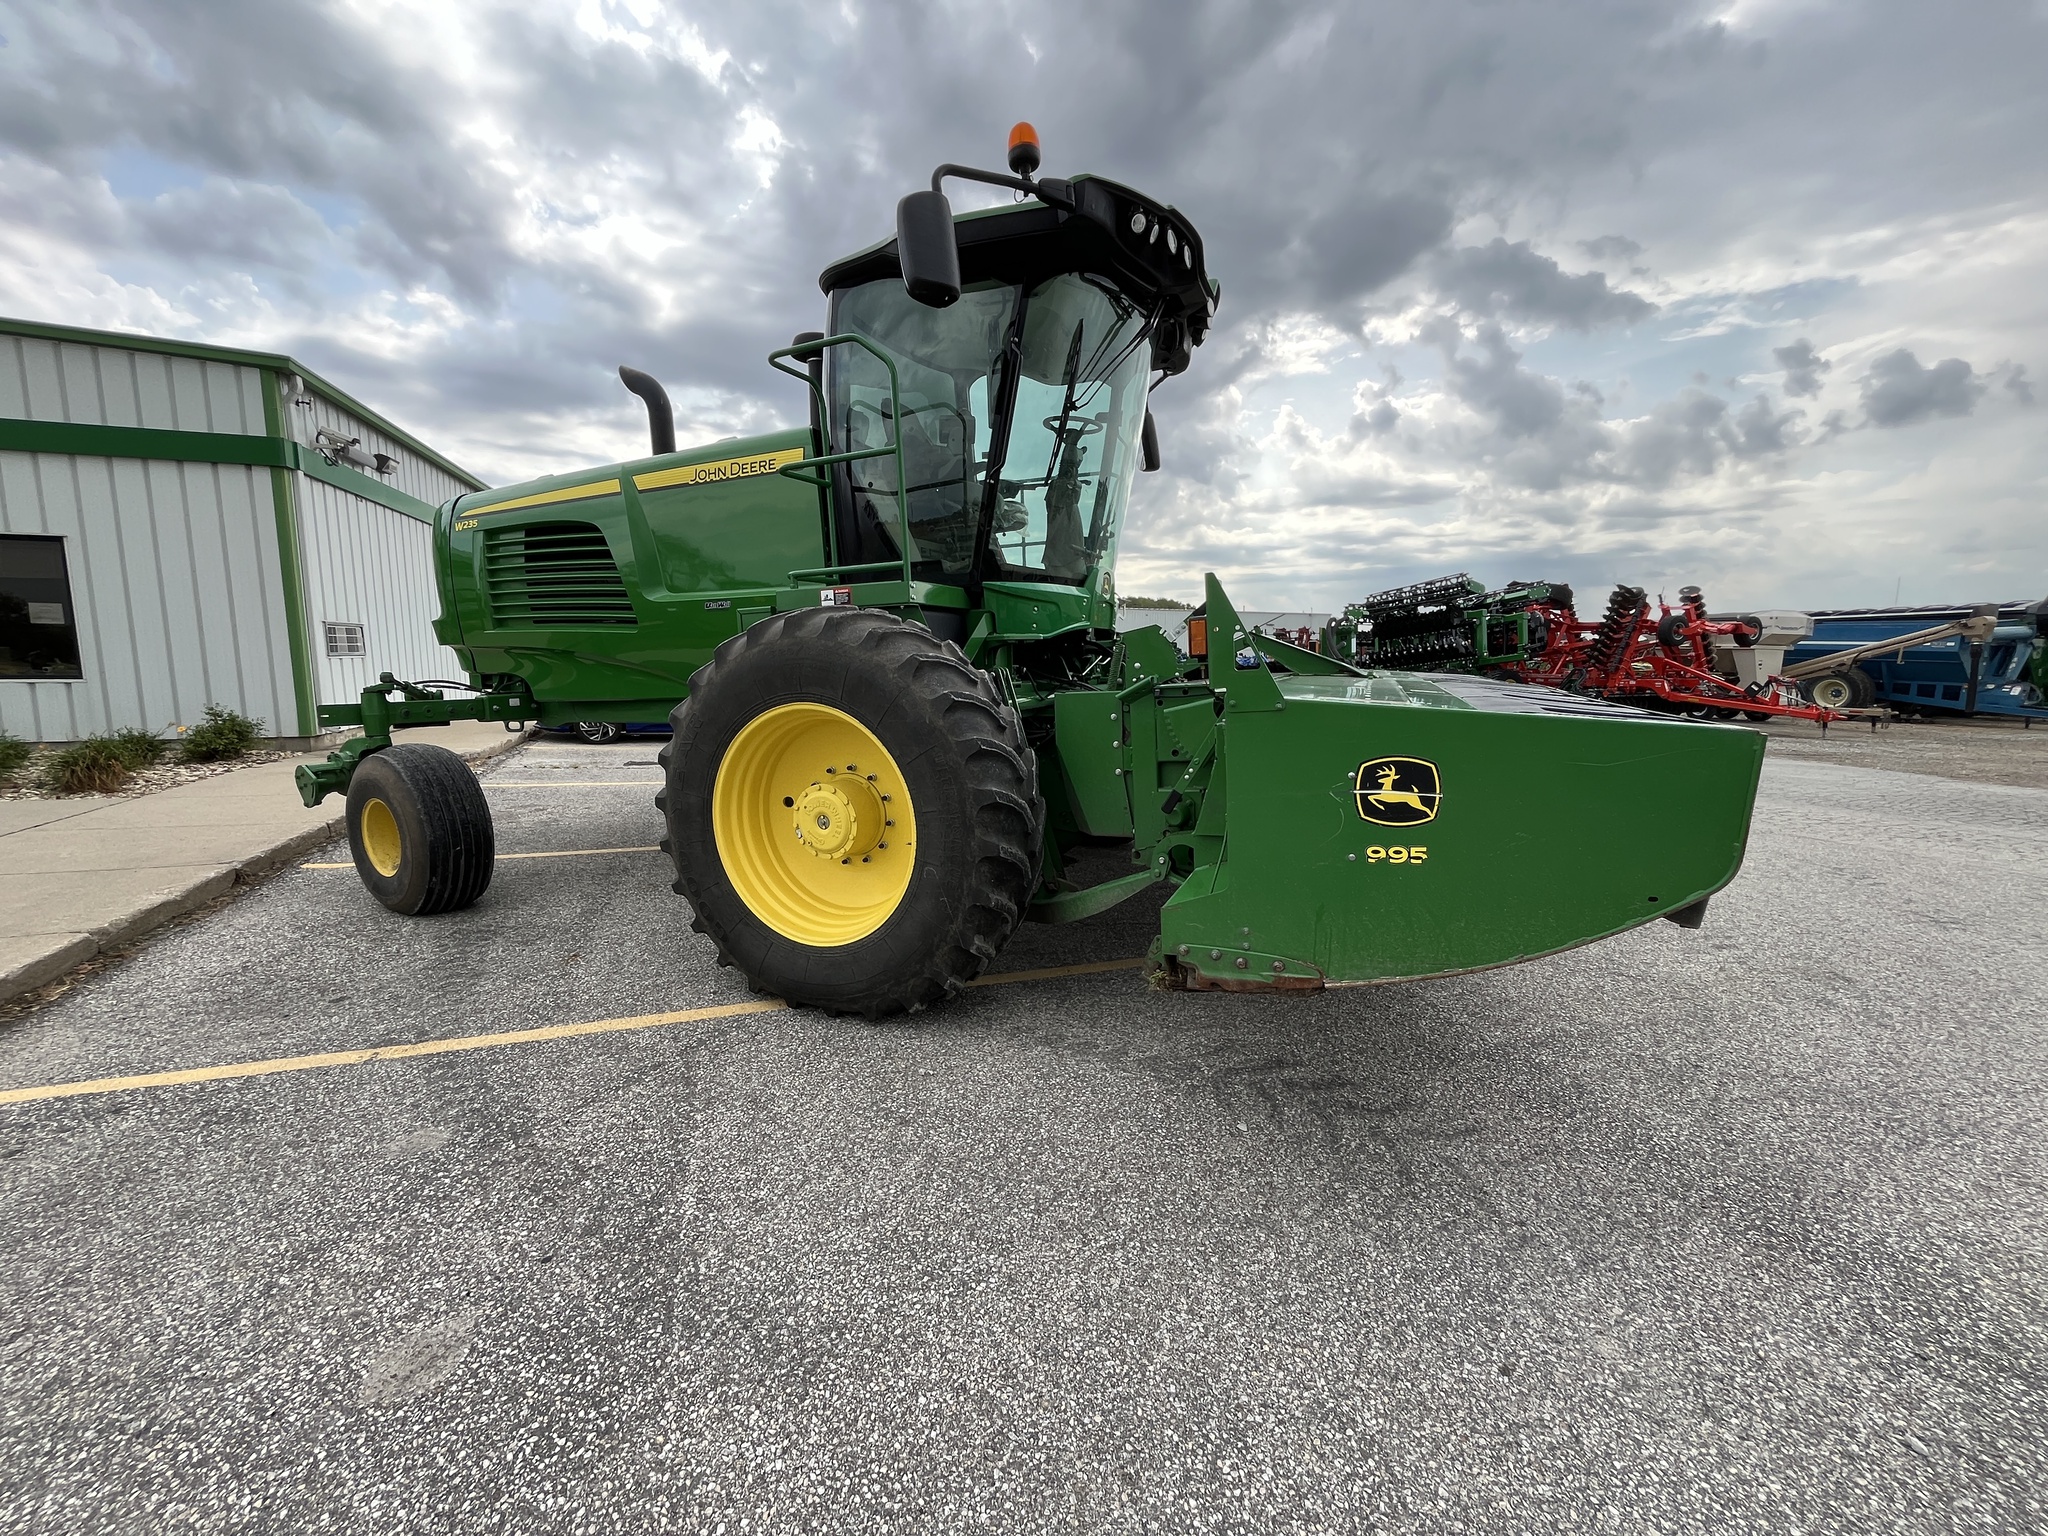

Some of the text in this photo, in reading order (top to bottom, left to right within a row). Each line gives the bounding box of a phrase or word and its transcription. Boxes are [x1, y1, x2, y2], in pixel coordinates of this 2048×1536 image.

[689, 458, 777, 483] JOHN DEERE
[454, 519, 479, 532] W235
[1366, 845, 1428, 864] 995
